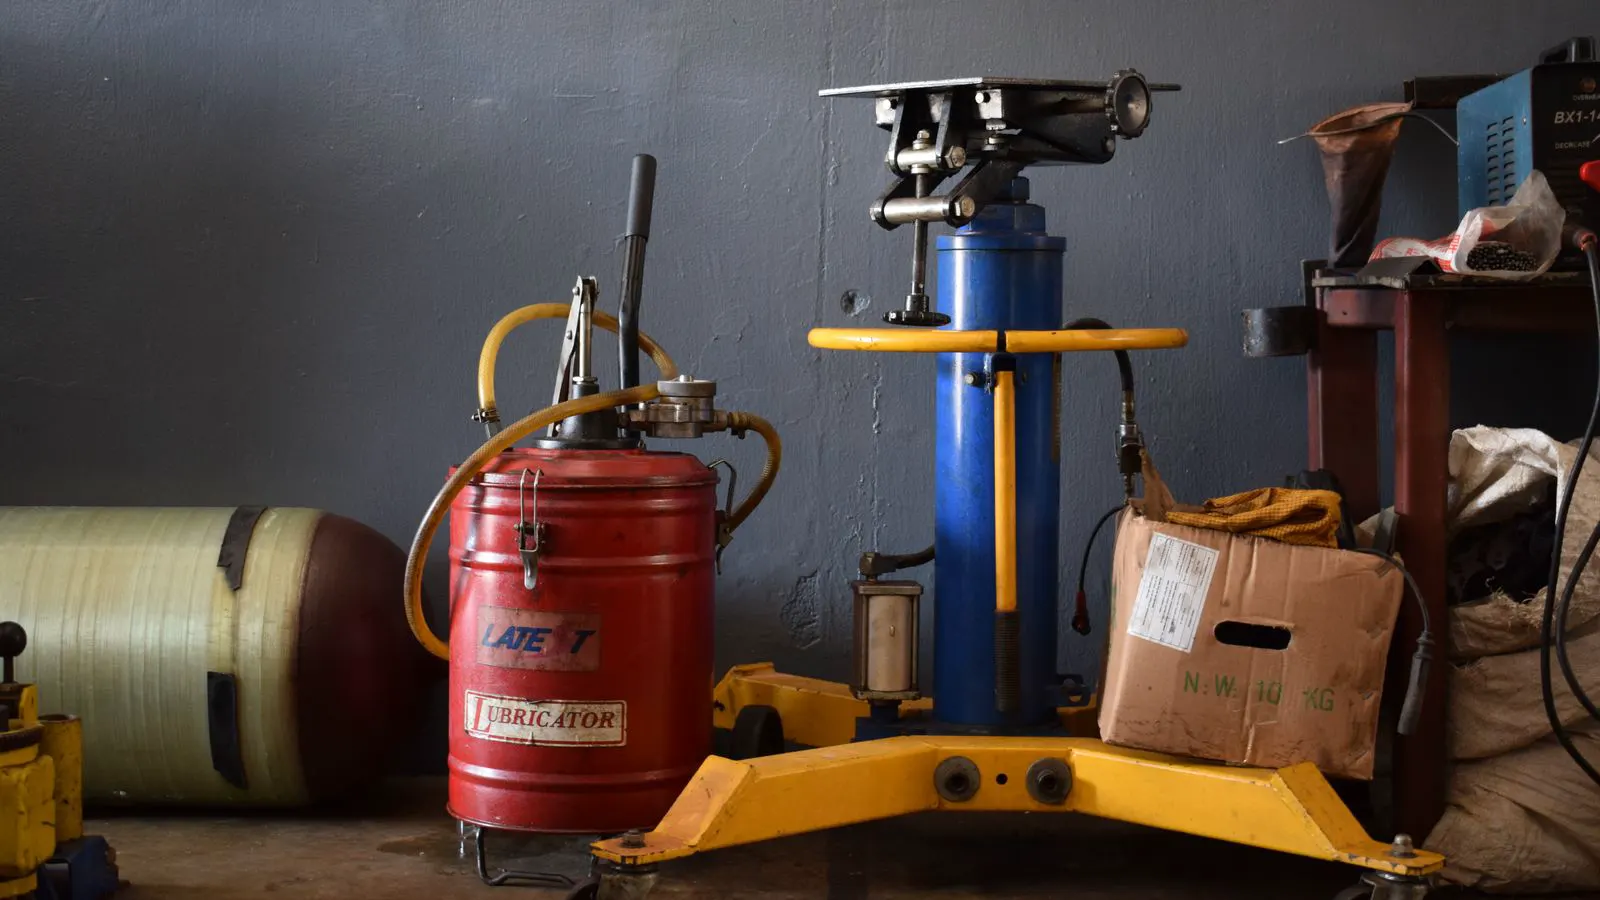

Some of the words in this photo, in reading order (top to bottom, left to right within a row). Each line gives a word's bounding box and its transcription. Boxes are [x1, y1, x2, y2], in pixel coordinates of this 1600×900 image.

[481, 623, 596, 654] LATET
[1256, 680, 1282, 706] 10
[1303, 687, 1335, 712] KG
[470, 696, 616, 733] LUBRICATOR
